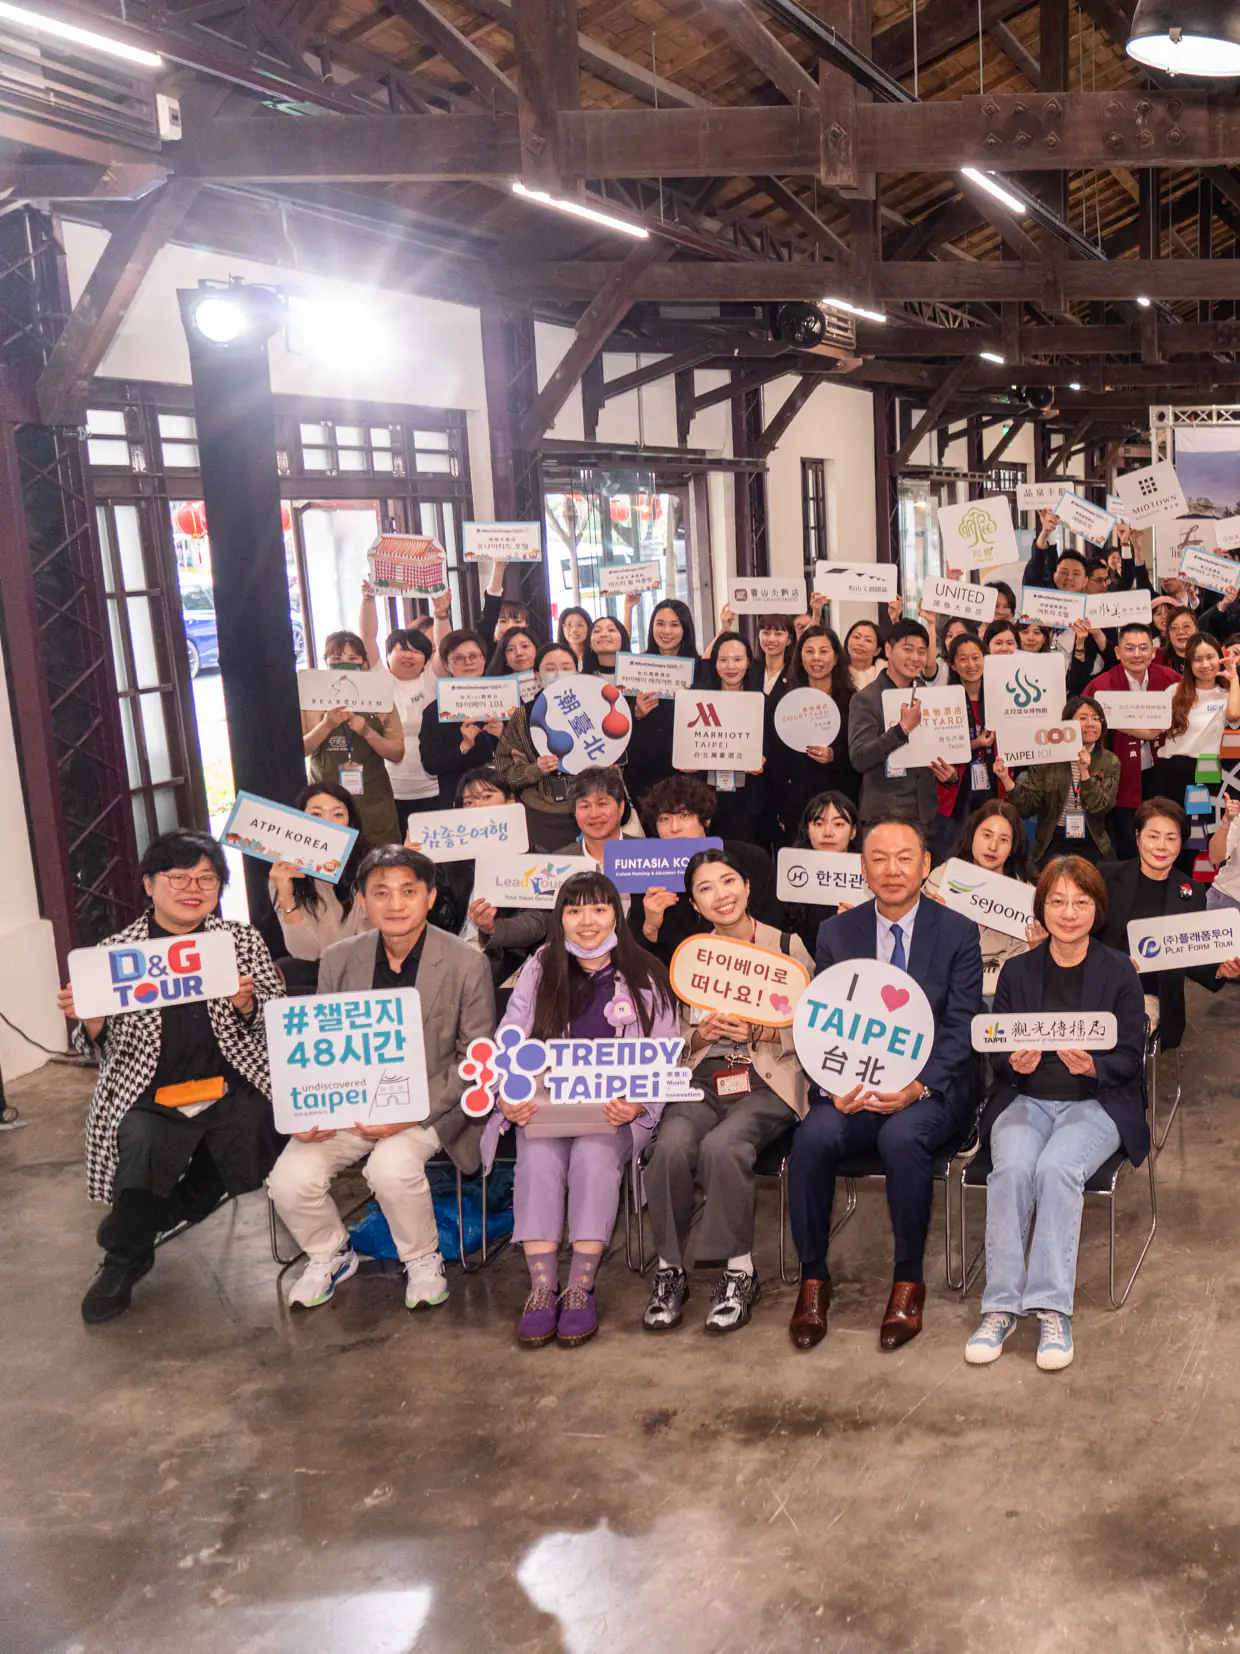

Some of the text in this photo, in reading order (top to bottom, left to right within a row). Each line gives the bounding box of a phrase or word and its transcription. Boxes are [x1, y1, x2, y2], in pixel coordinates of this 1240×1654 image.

[1132, 495, 1178, 515] MIDTOWN
[935, 582, 985, 604] UNITED
[782, 710, 829, 722] COURTYARD
[1004, 707, 1048, 716] 北投溫泉博物館
[694, 731, 750, 740] MARRIOTT
[694, 741, 728, 749] TAIPEI
[694, 751, 743, 760] 台北萬豪酒店
[1004, 750, 1034, 761] TAIPEI
[249, 818, 330, 853] ATPI KOREA
[421, 818, 509, 849] 참좋은여행
[615, 857, 670, 870] FUNTASIA
[1163, 928, 1233, 946] (주)플래폼투어
[1165, 940, 1234, 955] PLAT FORM TOUR
[108, 939, 202, 984] D&G
[696, 948, 788, 986] 타이베이로
[112, 975, 204, 1009] TOUR
[691, 972, 763, 1008] 떠나요!
[847, 973, 860, 1002] I
[807, 999, 925, 1061] TAIPEI
[1011, 1020, 1106, 1037] 觀光傳播局
[286, 1029, 407, 1069] 48시간
[550, 1042, 681, 1067] TRENDY
[821, 1045, 885, 1086] 台北
[302, 1078, 367, 1093] undiscovered
[290, 1087, 368, 1114] taipei
